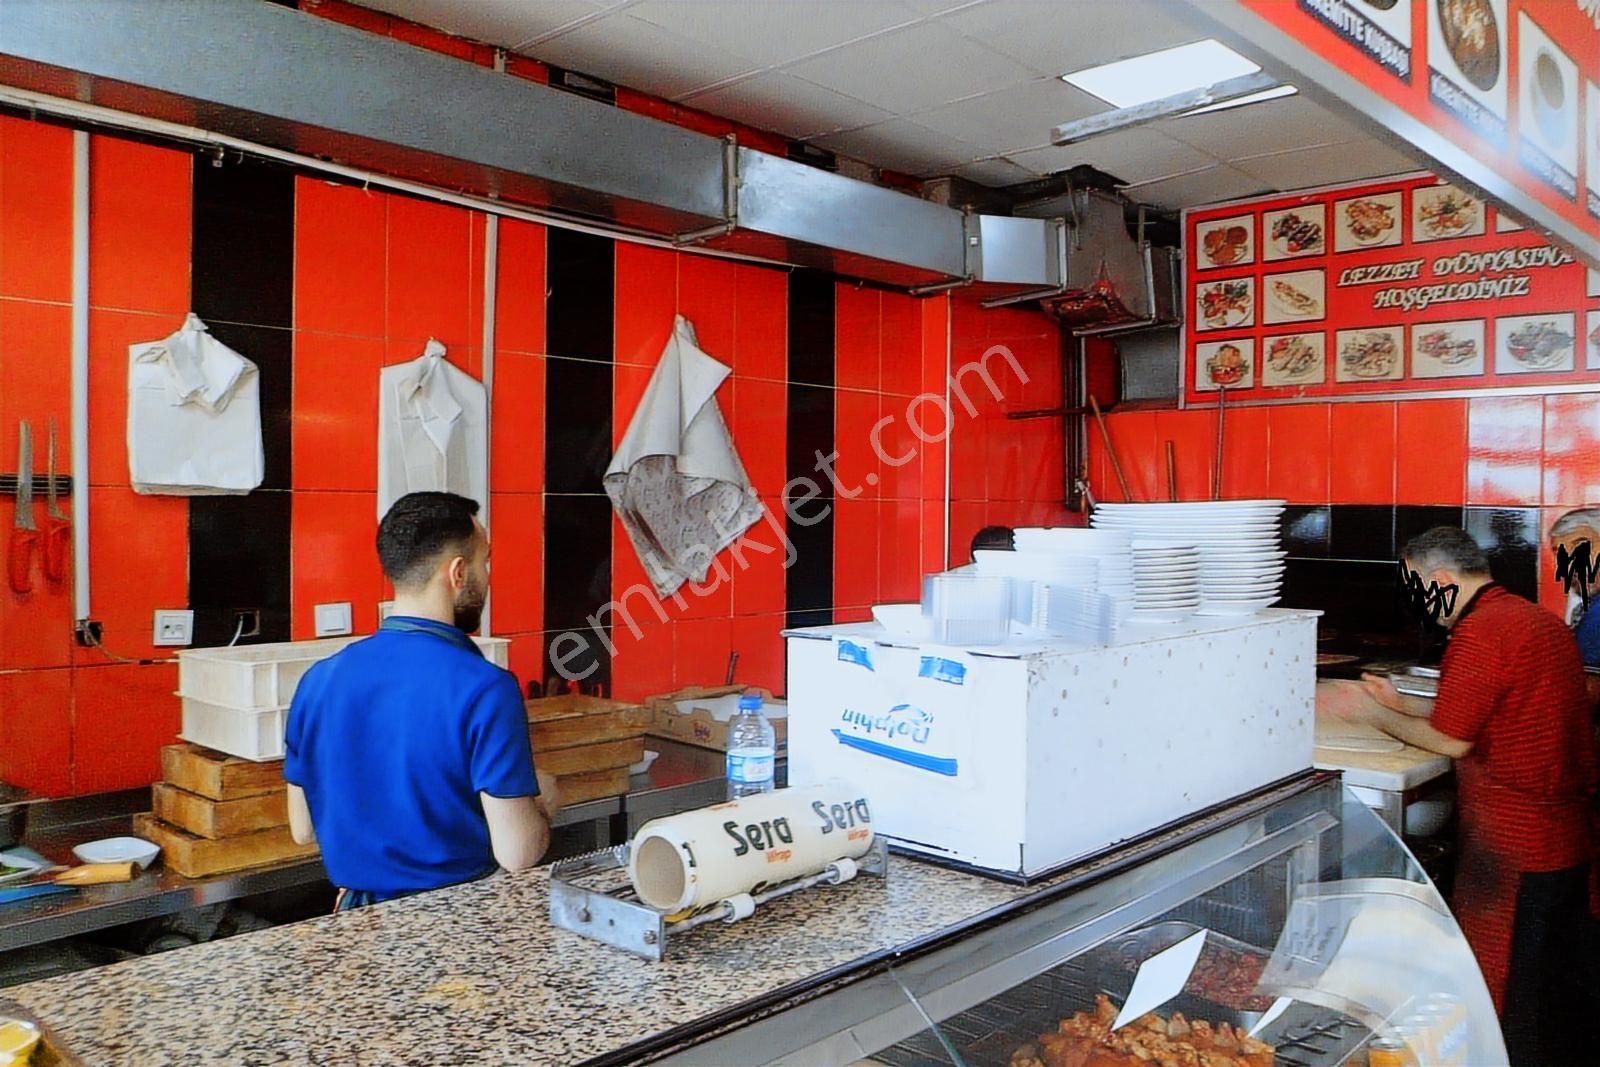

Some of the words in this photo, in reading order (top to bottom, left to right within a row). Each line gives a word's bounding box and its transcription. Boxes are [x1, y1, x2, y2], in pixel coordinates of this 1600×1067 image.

[1337, 259, 1424, 287] LEZZET
[1372, 274, 1530, 311] HOŞGELDİNİZ
[841, 708, 930, 744] Dolphin
[812, 798, 871, 834] Sera
[723, 817, 793, 856] Sera
[766, 849, 793, 864] Wrap
